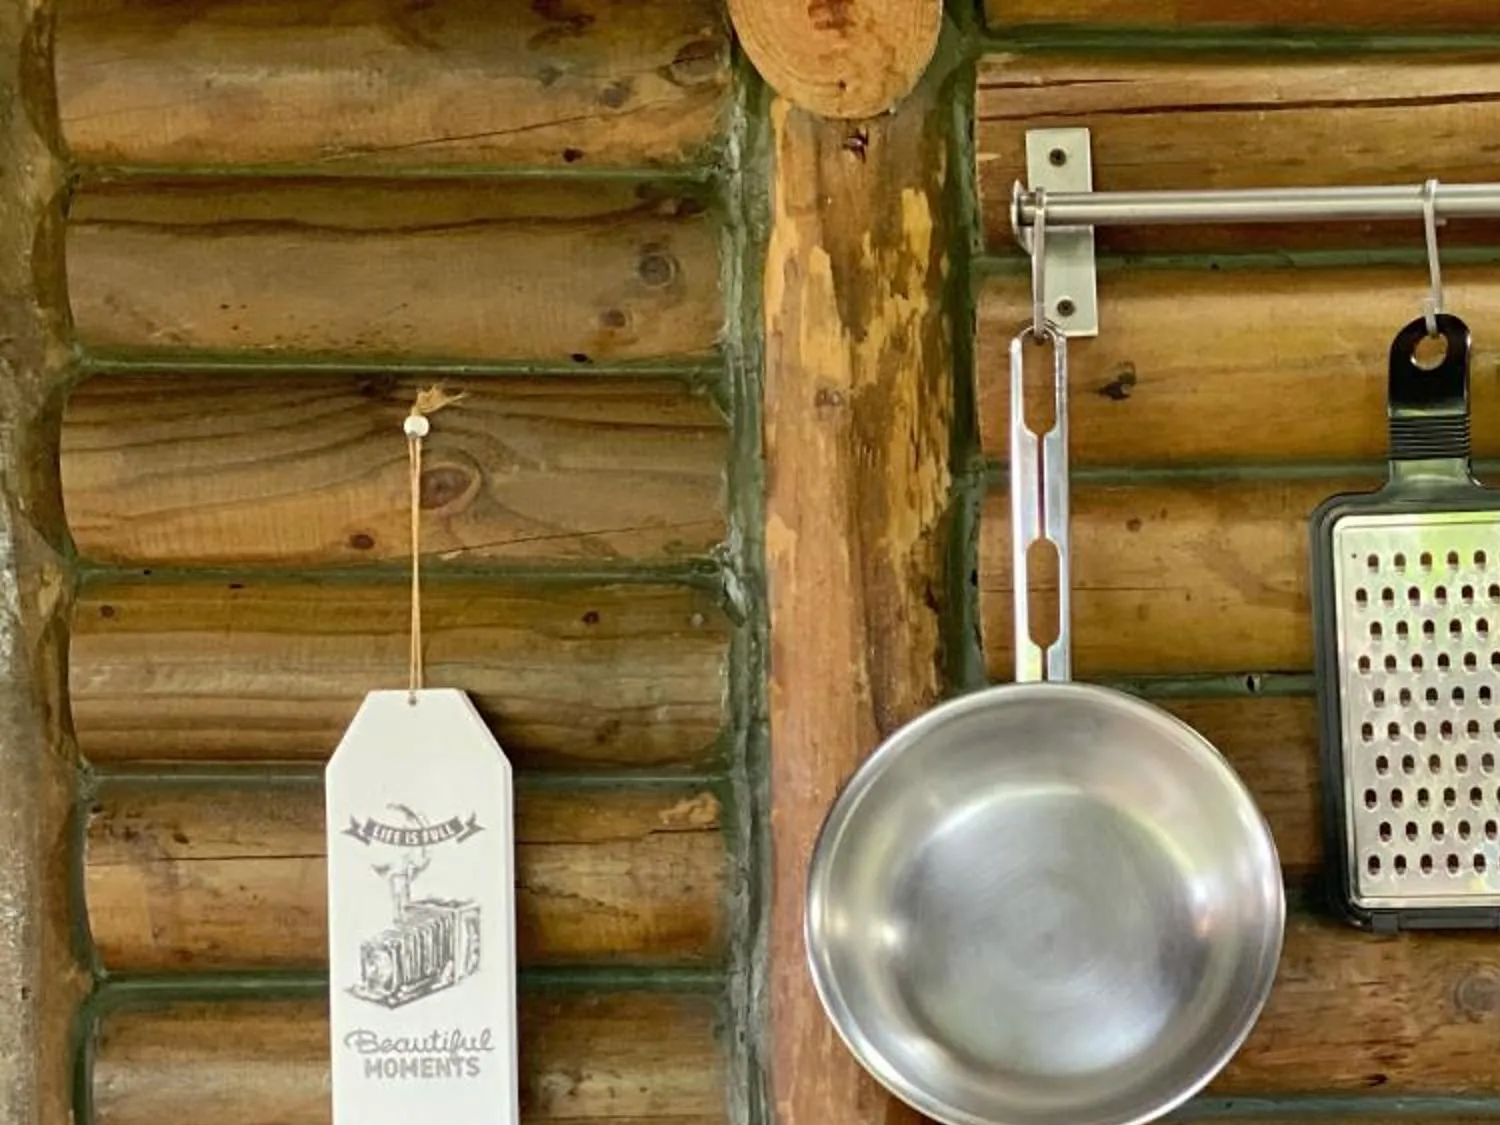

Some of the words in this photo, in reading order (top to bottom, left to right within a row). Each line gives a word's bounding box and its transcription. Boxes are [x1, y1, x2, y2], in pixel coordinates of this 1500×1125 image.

[372, 824, 401, 844] LIFE
[405, 830, 419, 845] IS
[422, 824, 455, 843] FULL
[343, 1028, 495, 1058] Beautiful
[364, 1056, 481, 1079] MOMENTS
